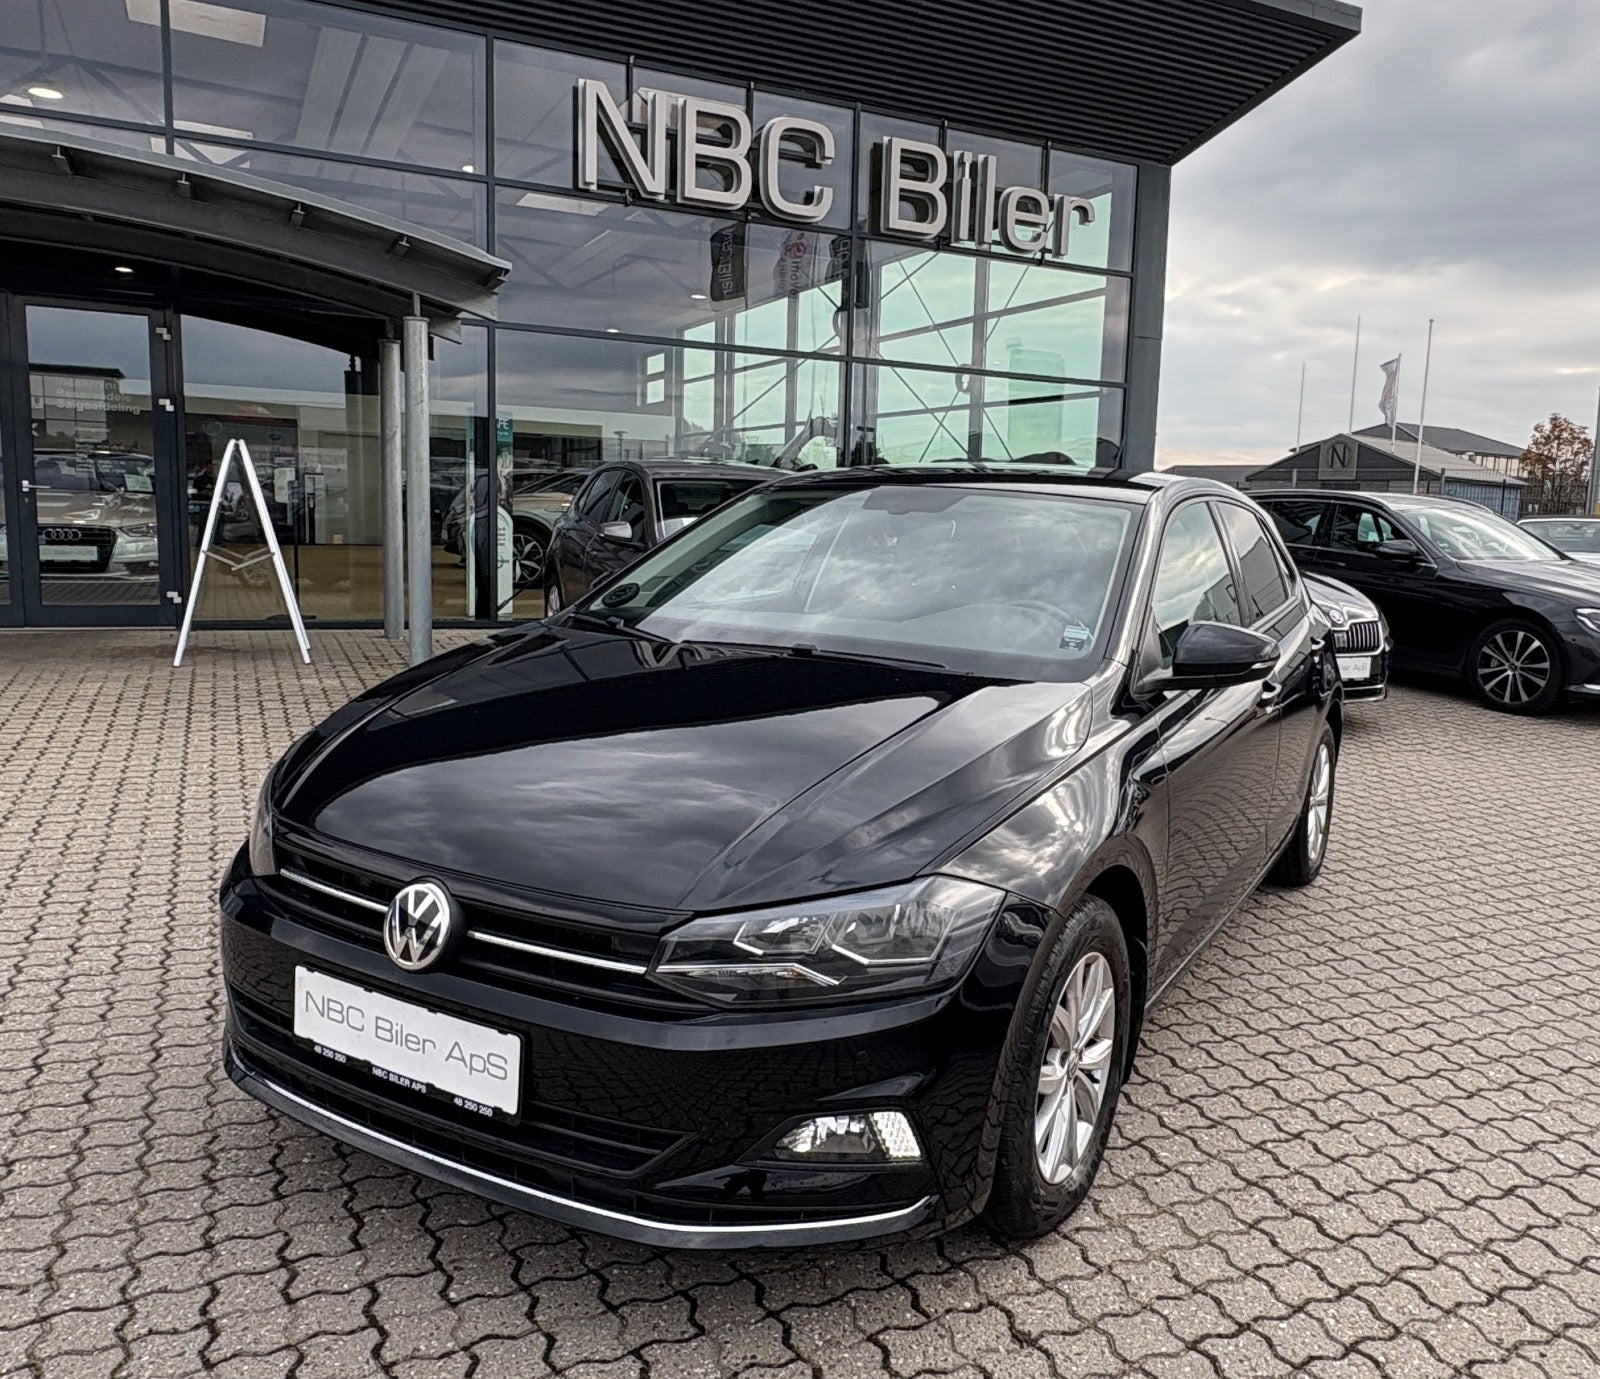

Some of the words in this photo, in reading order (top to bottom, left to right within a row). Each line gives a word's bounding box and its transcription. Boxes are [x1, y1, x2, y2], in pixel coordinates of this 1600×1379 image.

[577, 78, 836, 224] NBC
[882, 135, 1096, 259] Biler
[1330, 442, 1348, 469] N
[305, 990, 365, 1032] NBC
[375, 1015, 437, 1055] Biler
[445, 1041, 508, 1081] ApS
[372, 1066, 388, 1080] NBC
[388, 1072, 411, 1088] BILER
[411, 1080, 427, 1094] APS
[463, 1100, 478, 1113] 250
[478, 1105, 494, 1118] 250
